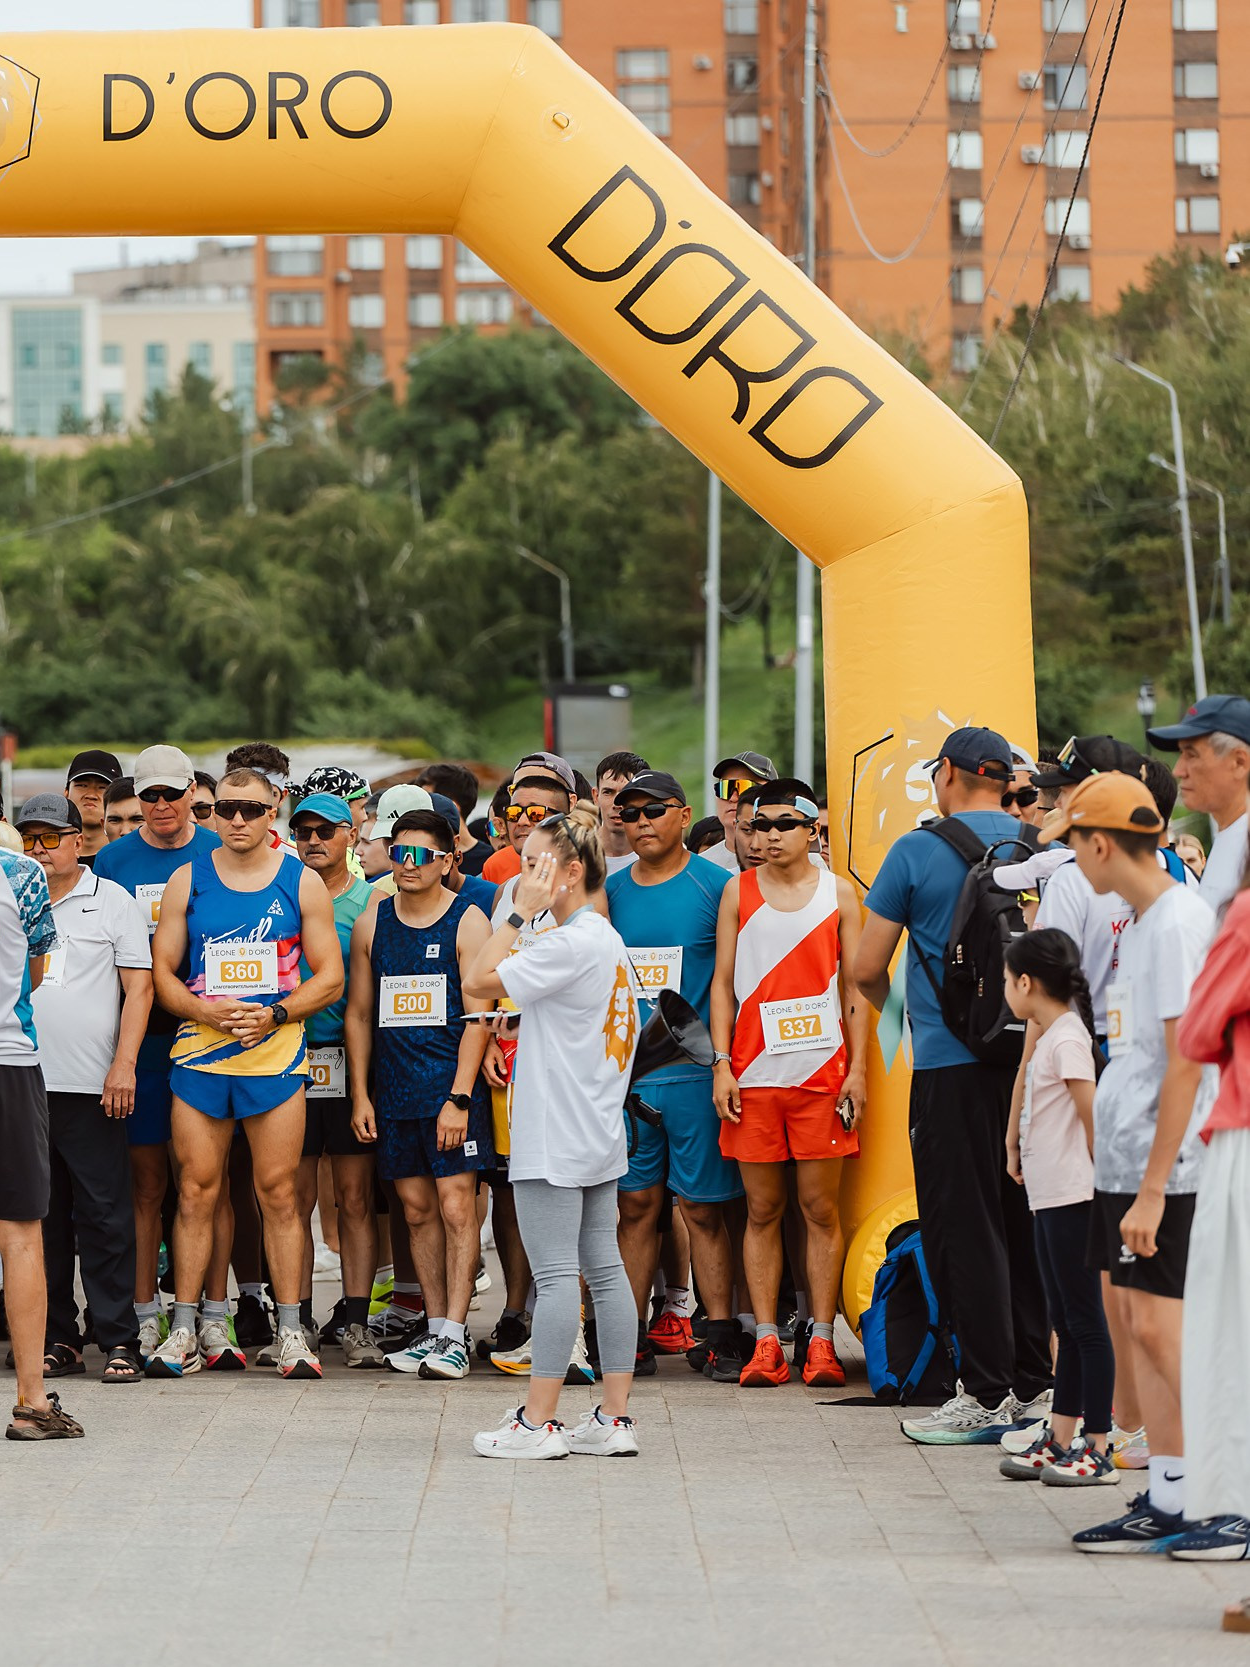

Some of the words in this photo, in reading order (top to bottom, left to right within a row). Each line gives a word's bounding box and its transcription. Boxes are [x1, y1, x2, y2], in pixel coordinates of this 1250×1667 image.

[103, 70, 392, 142] D'ORO
[211, 949, 236, 957] LEONE
[224, 963, 258, 980] 360
[636, 967, 665, 984] 343
[397, 995, 428, 1012] 500
[766, 1006, 792, 1015] LEONE
[782, 1017, 817, 1037] 337
